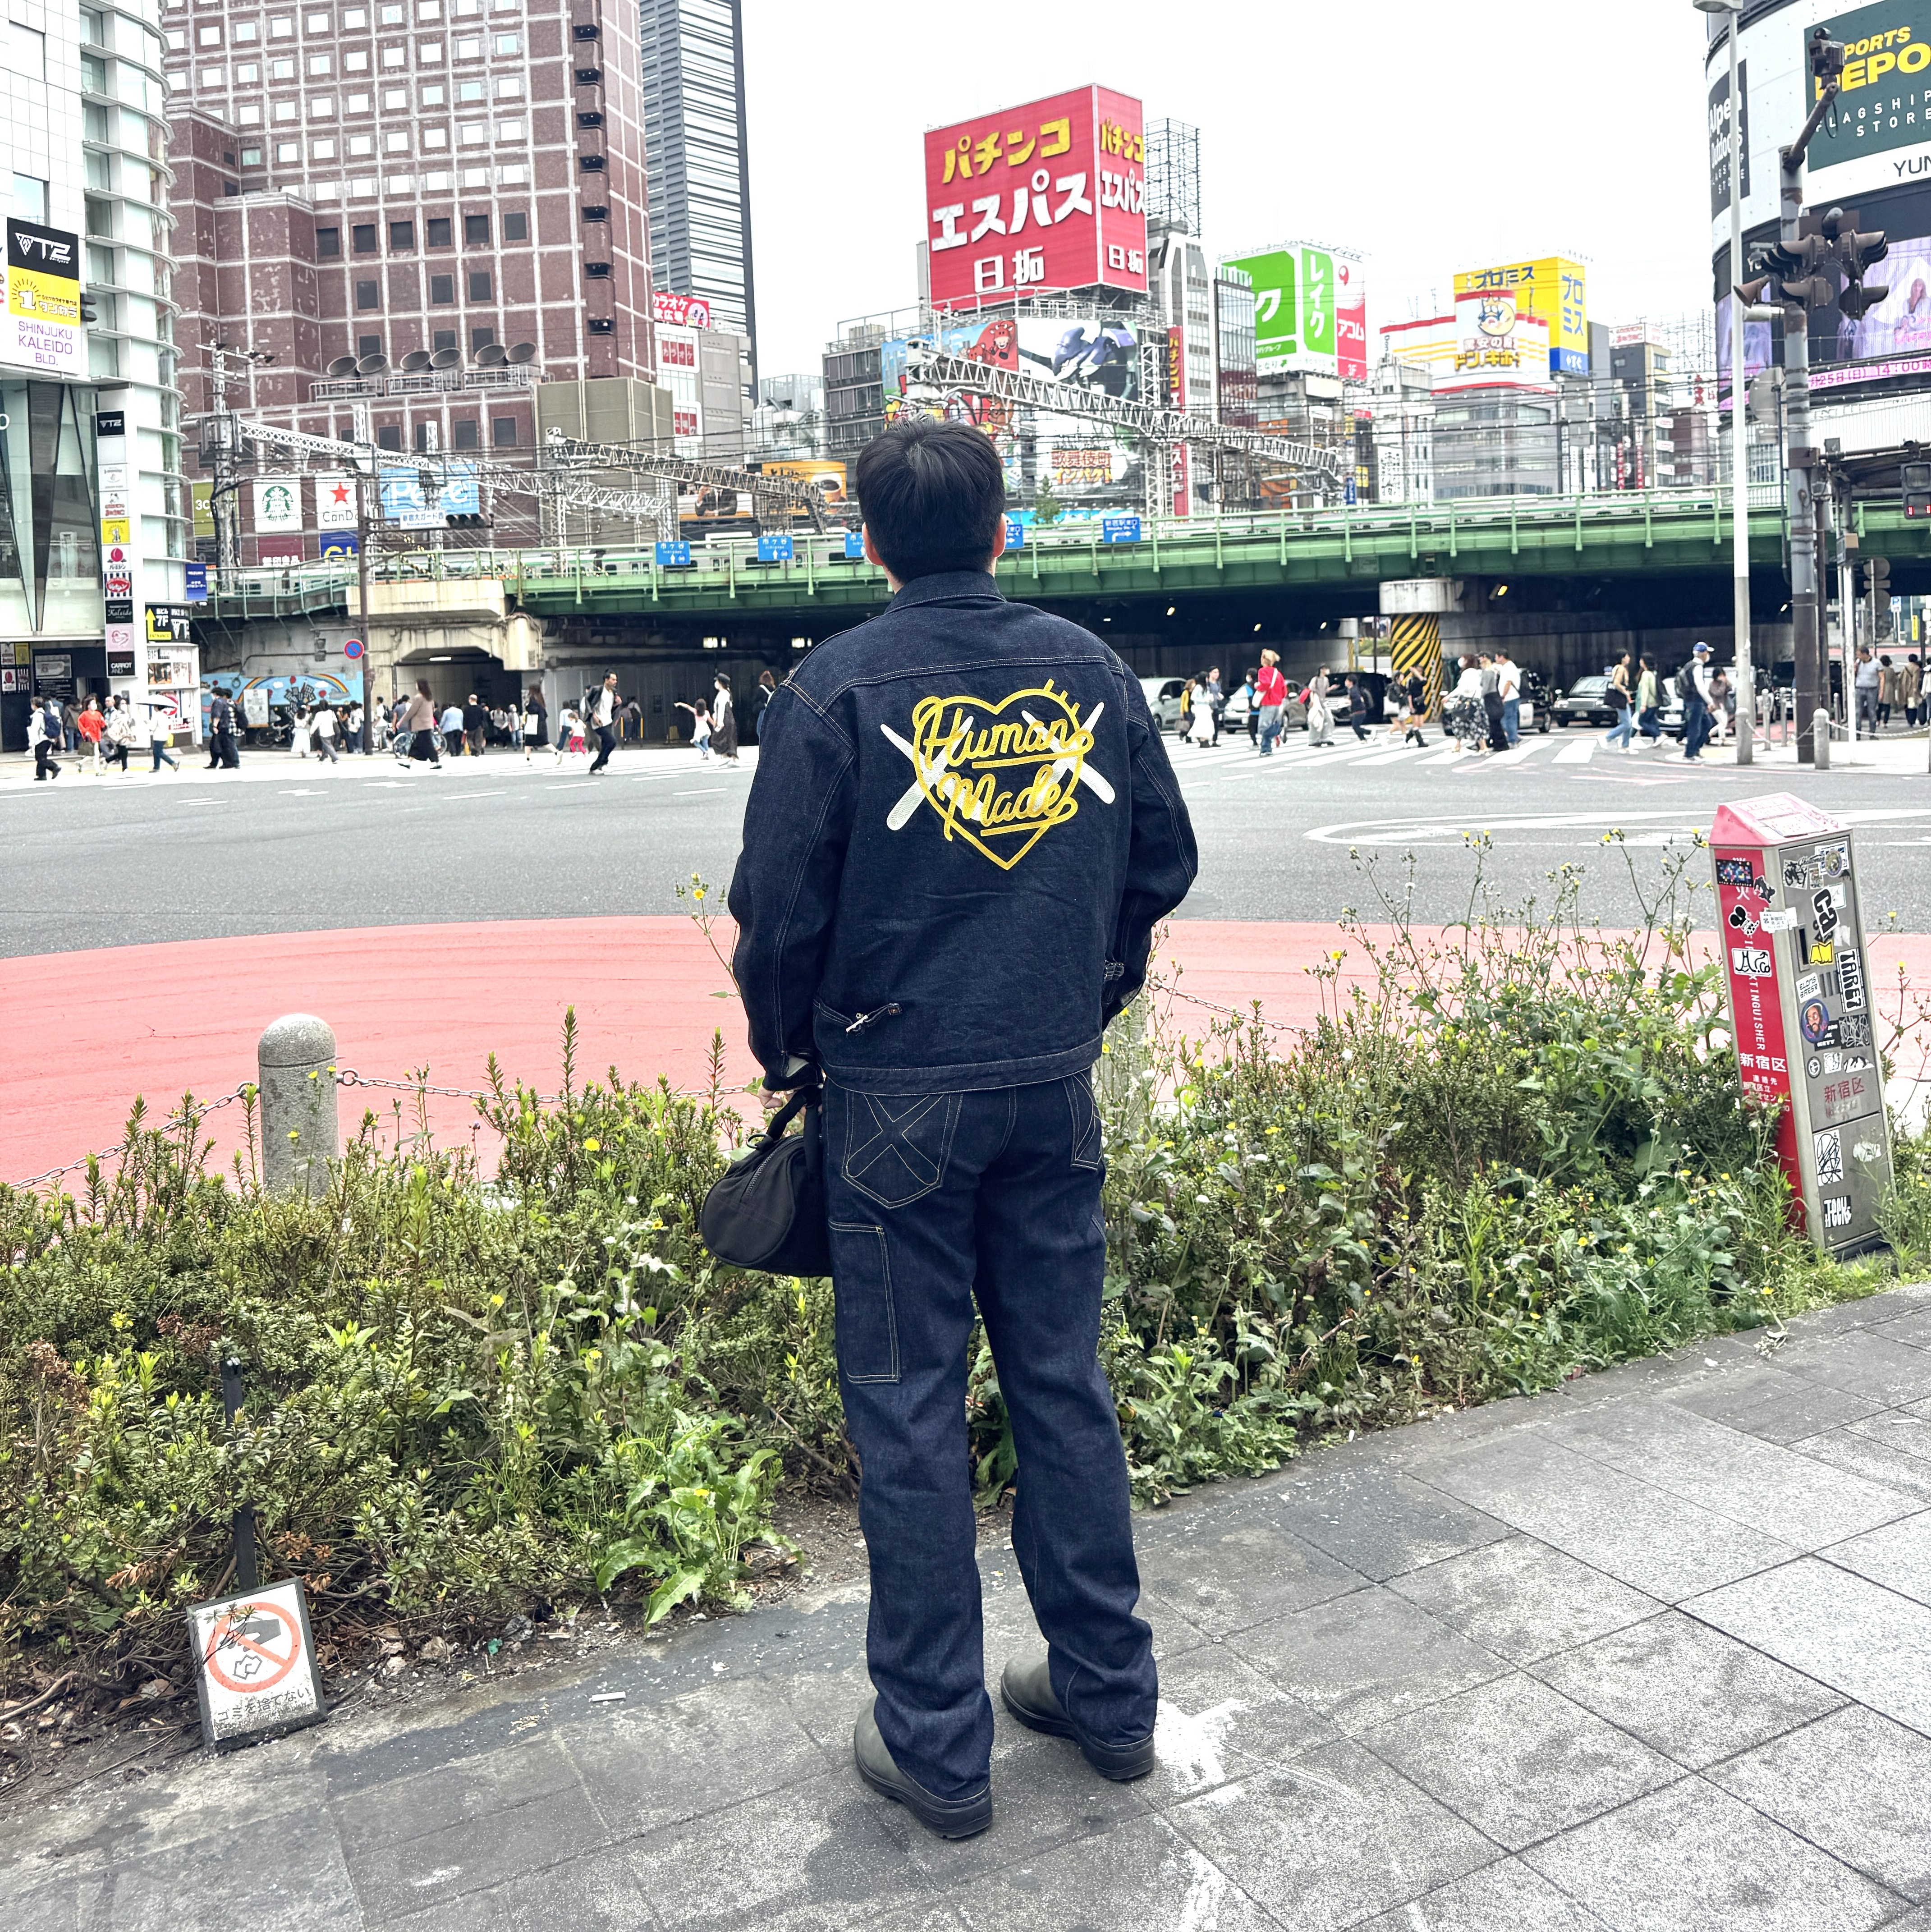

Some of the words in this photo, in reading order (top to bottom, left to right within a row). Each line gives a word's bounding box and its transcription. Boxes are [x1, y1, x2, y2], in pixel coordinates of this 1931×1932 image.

[1844, 26, 1912, 60] PORTS
[1856, 107, 1931, 137] STORE
[942, 116, 1070, 184] パチンコ
[1101, 116, 1144, 163] パチンコ
[1101, 169, 1145, 214] エスパス
[931, 168, 1092, 252] エスパス
[973, 246, 1045, 293] 日拓
[1473, 266, 1535, 289] プロミス
[1310, 254, 1325, 338] レイク
[18, 321, 72, 340] SHINJUKU
[18, 334, 73, 355] KALEIDO
[1337, 318, 1365, 341] アコム
[35, 352, 58, 366] BLD.
[156, 615, 169, 627] 7F
[913, 696, 1094, 769] Human
[937, 764, 1078, 841] Made
[1749, 975, 1766, 1051] XTINGUISHER
[1739, 1053, 1787, 1072] 新宿区
[1824, 1077, 1865, 1103] 新宿区
[218, 1688, 311, 1722] ゴミを捨てない
